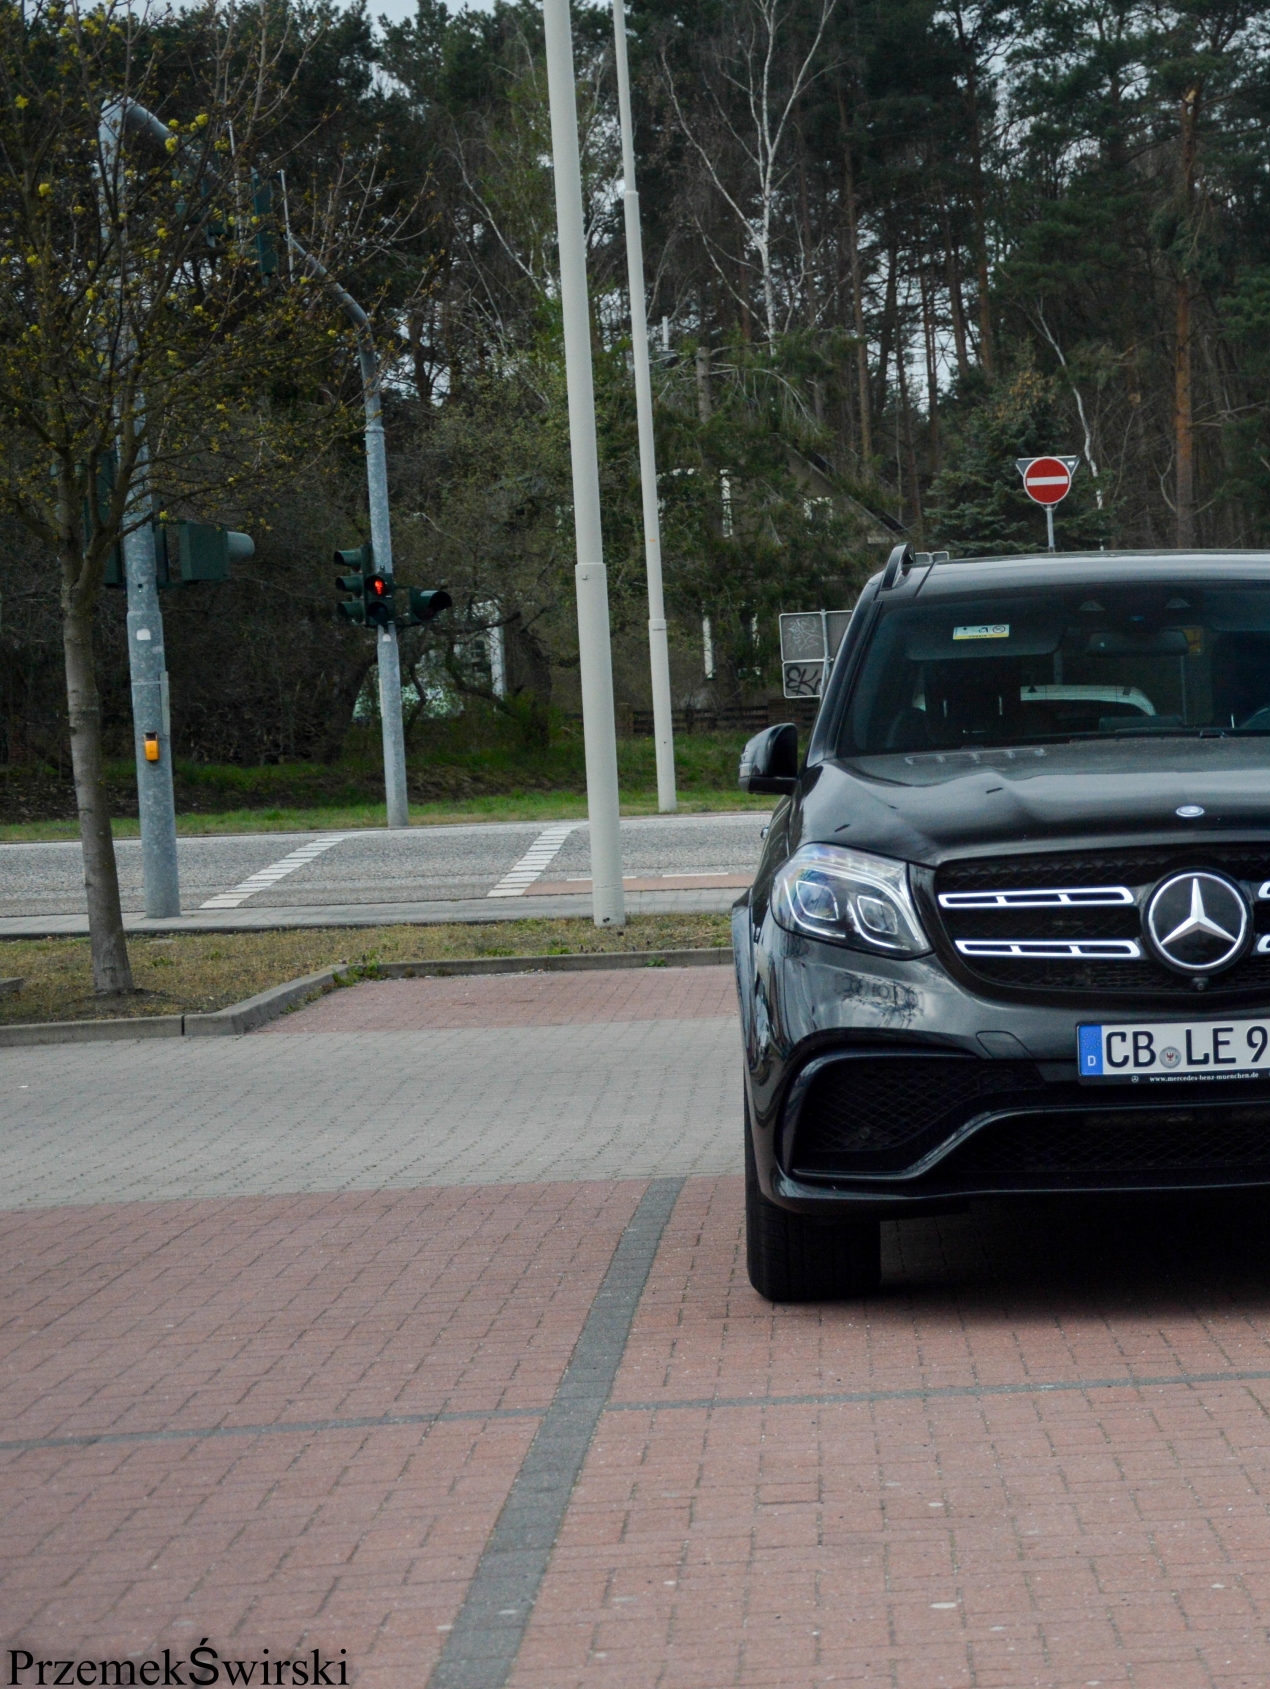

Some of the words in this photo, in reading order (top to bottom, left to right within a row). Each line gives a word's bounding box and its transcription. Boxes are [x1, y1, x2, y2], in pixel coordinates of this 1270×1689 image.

[1087, 1055, 1097, 1067] D
[1105, 1030, 1157, 1068] CB
[1185, 1026, 1237, 1066] LE
[1149, 1071, 1259, 1082] www.mercedes-benz-muenchen.de
